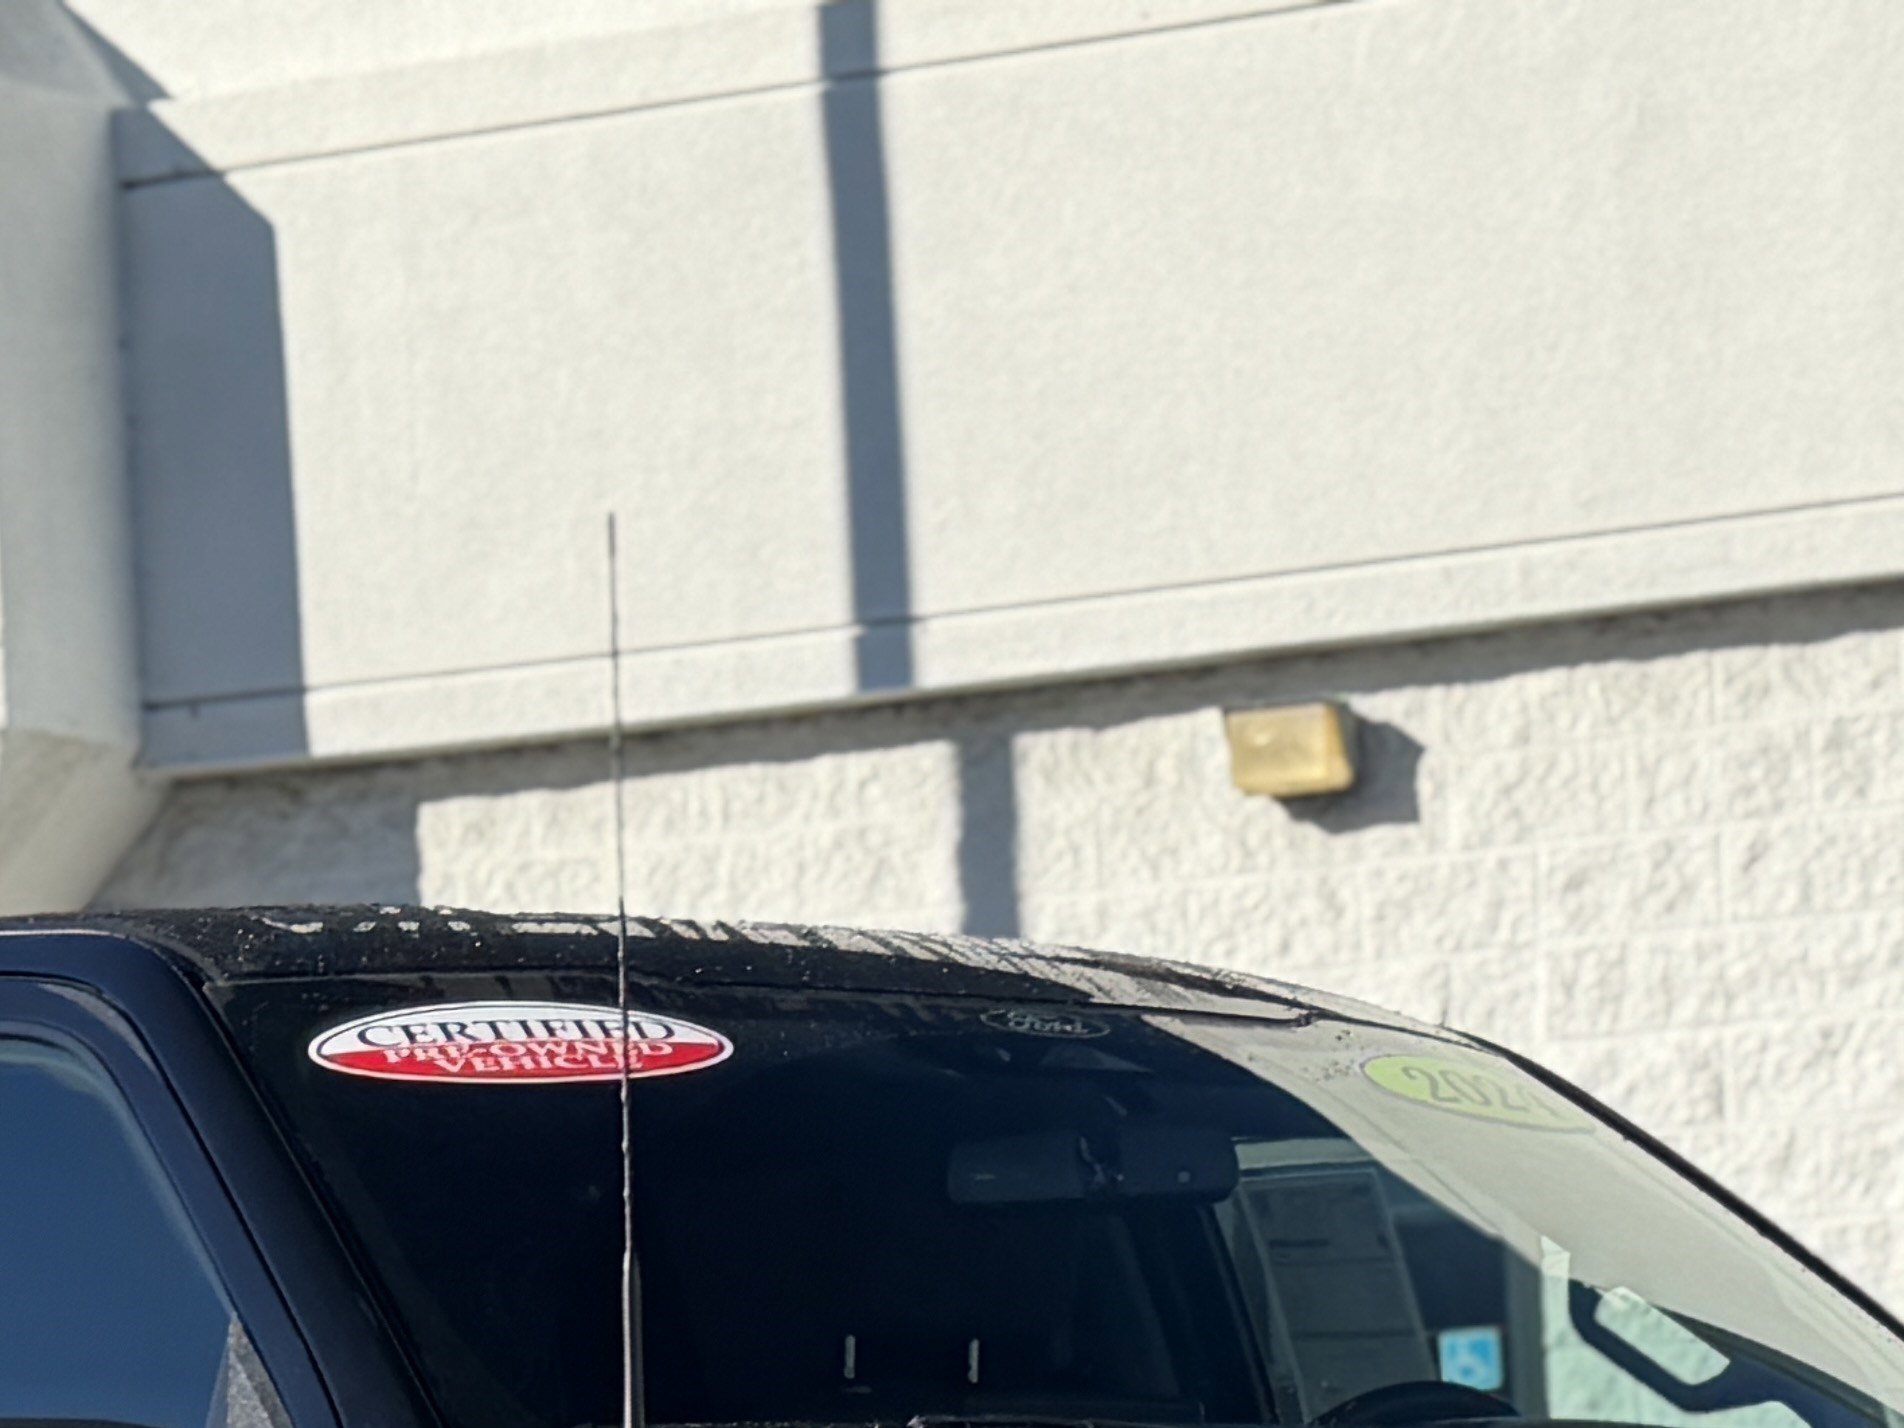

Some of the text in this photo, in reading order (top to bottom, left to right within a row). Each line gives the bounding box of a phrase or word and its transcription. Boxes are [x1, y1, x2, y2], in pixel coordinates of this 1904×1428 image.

[357, 1019, 675, 1047] CERTIFIED
[383, 1039, 674, 1063] PRE-OWNED
[436, 1053, 644, 1073] VEHICLE
